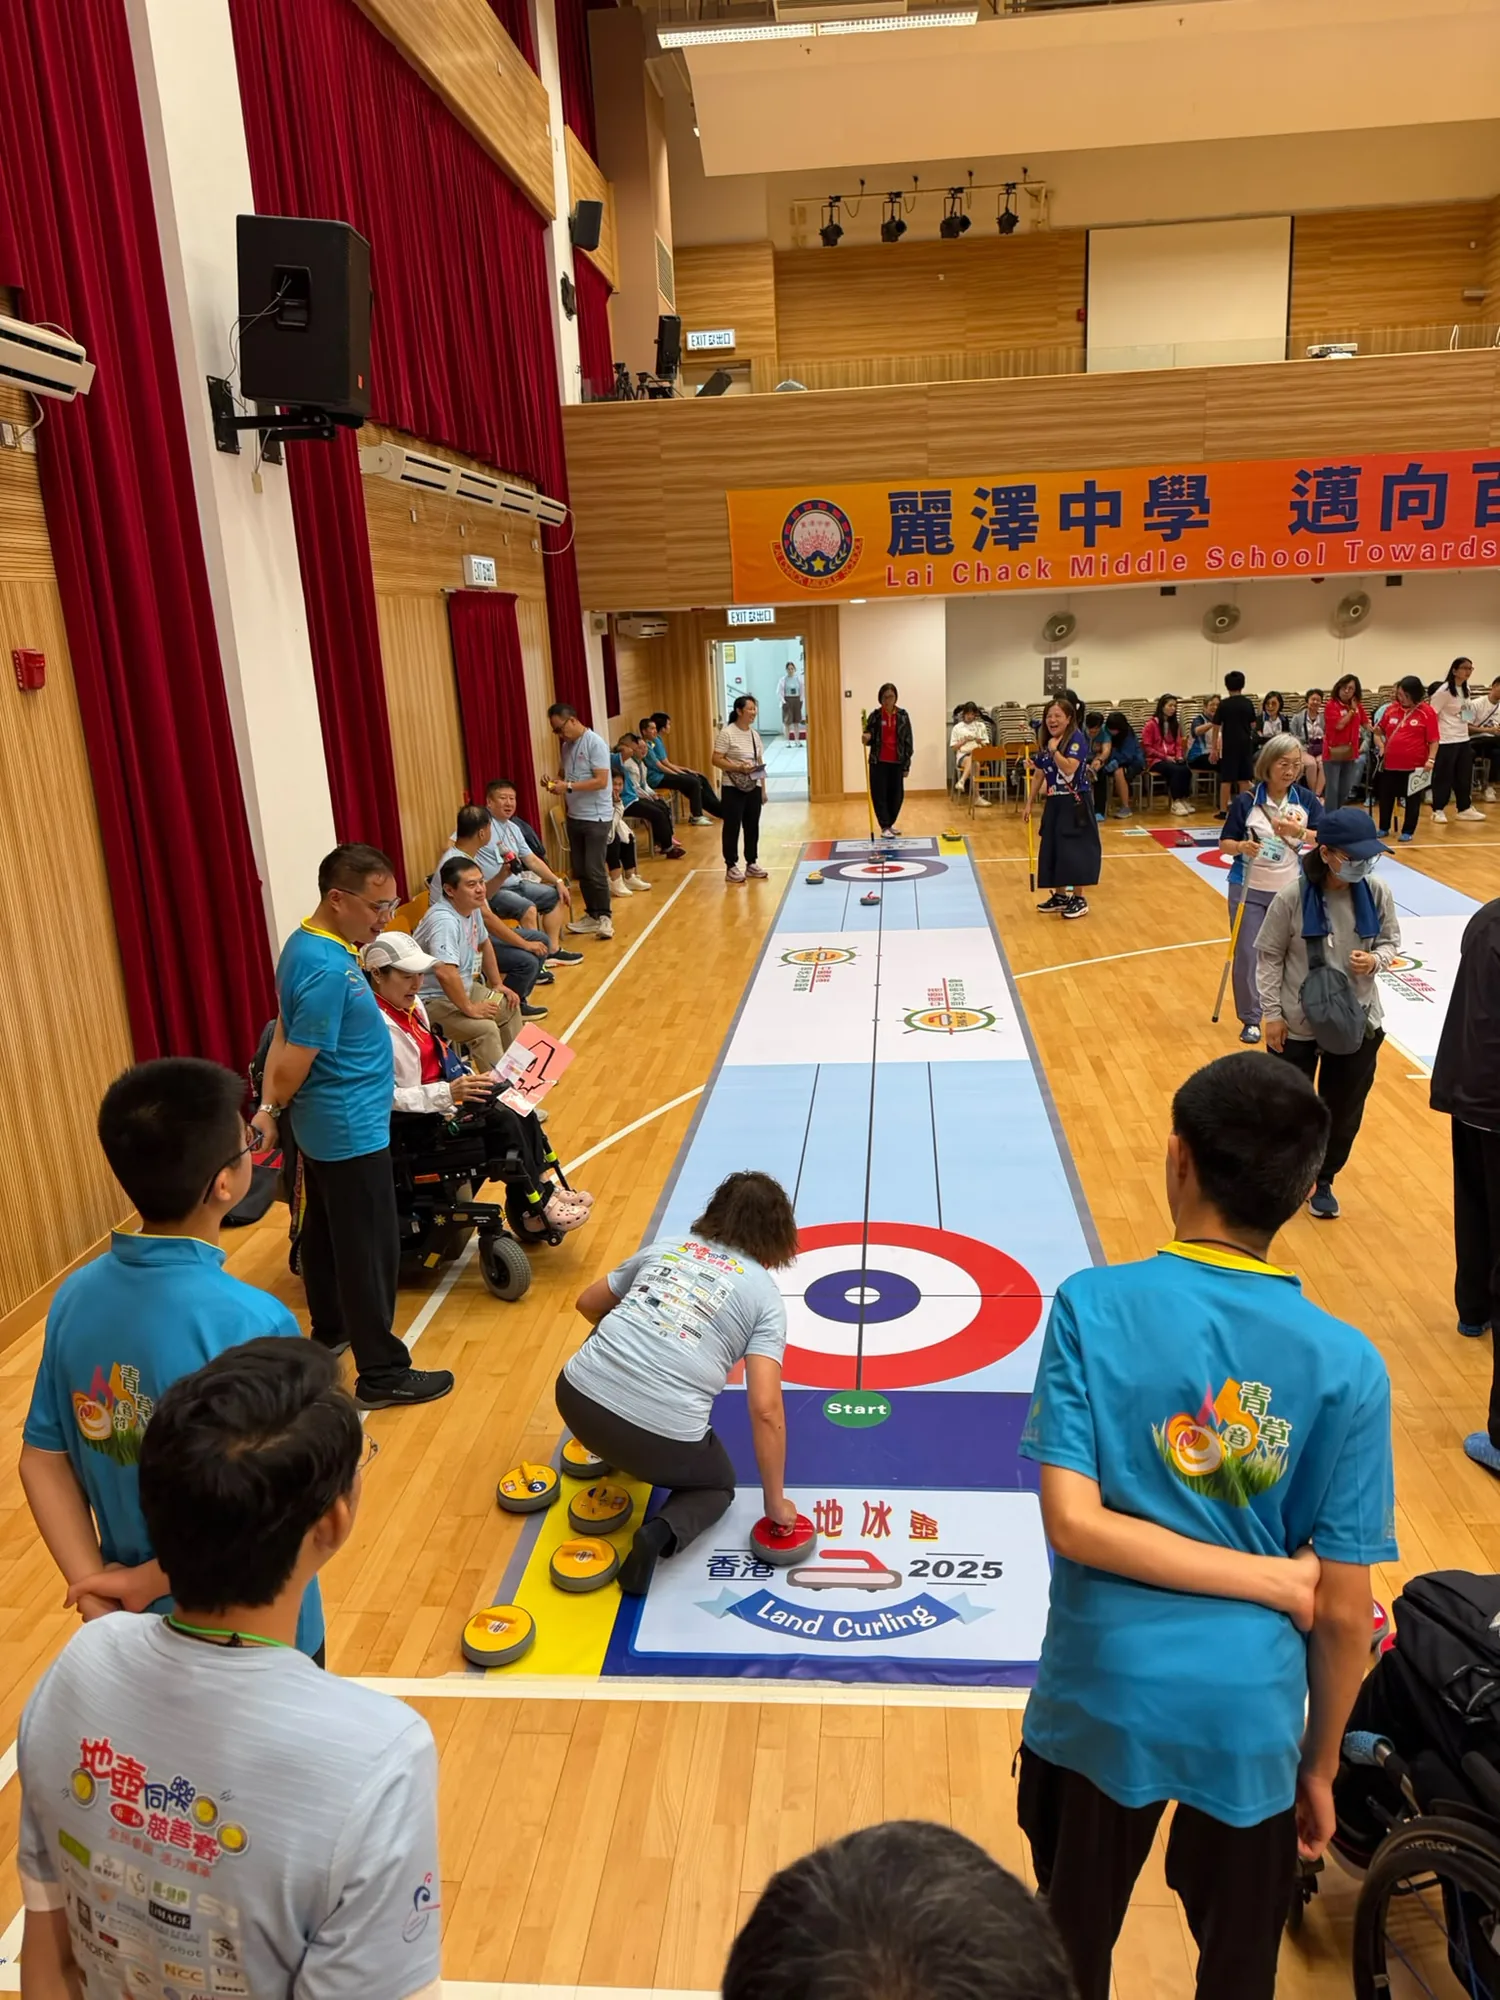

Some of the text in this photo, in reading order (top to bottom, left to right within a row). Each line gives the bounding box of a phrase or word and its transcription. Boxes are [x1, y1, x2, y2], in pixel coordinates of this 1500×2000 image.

[691, 334, 707, 346] EXIT
[887, 475, 1210, 557] 麗澤中學
[886, 535, 1497, 588] Lai Chack Middle School Towards
[731, 611, 747, 623] EXIT
[827, 1402, 887, 1415] Start
[1240, 1383, 1291, 1447] 青草
[533, 1482, 542, 1491] 3
[707, 1555, 775, 1578] 香港
[908, 1559, 1003, 1580] 2025
[756, 1599, 937, 1638] Land Curling
[164, 1963, 203, 1983] NCC
